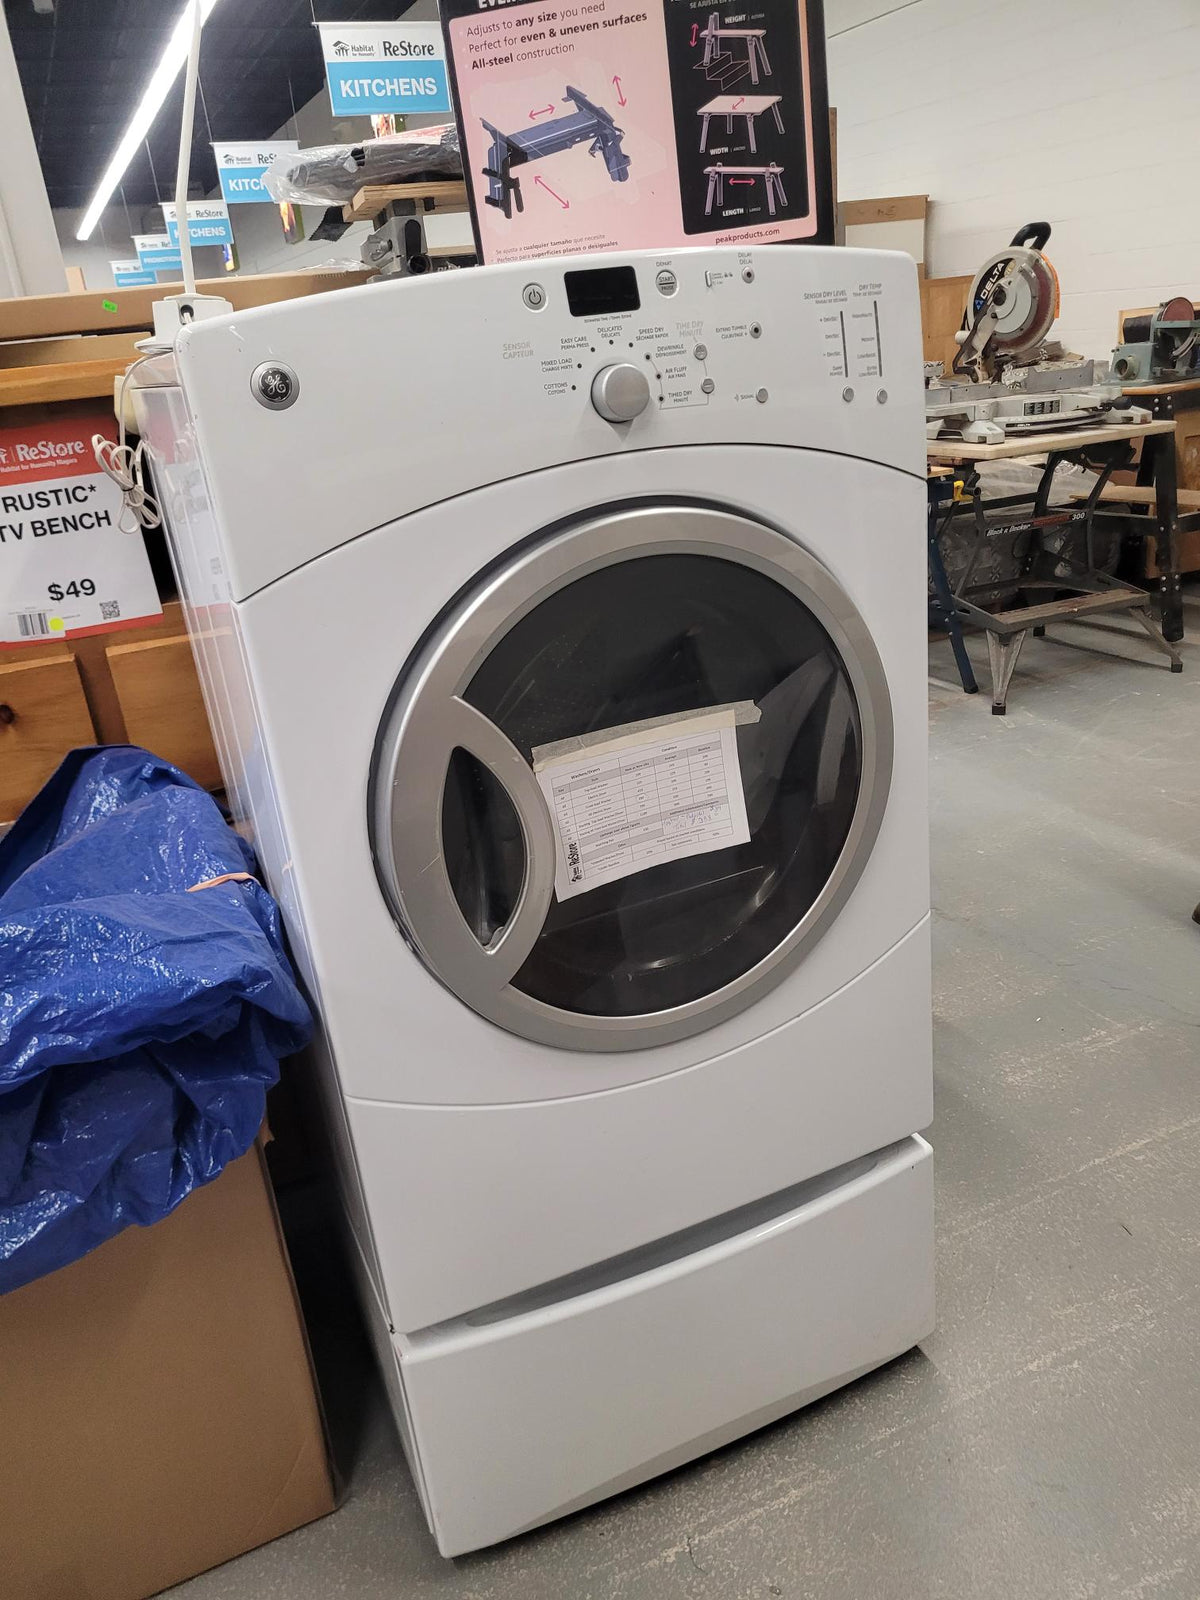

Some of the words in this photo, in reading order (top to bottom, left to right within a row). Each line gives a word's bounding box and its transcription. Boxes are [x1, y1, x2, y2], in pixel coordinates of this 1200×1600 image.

[466, 22, 500, 38] Adjusts
[502, 21, 512, 30] to
[516, 16, 534, 28] any
[538, 12, 558, 22] size
[560, 8, 578, 21] you
[581, 2, 606, 14] need
[724, 14, 746, 24] HEIGHT
[469, 39, 501, 53] Perfect
[504, 36, 518, 48] for
[520, 32, 546, 44] even
[549, 28, 556, 38] &
[560, 21, 600, 36] uneven
[602, 12, 648, 29] surfaces
[383, 40, 435, 56] ReStore
[472, 53, 514, 70] All-steel
[516, 42, 575, 62] construction
[340, 78, 438, 98] KITCHENS
[258, 153, 276, 164] ReS
[710, 146, 728, 156] WIDTH
[196, 210, 224, 218] ReStore
[722, 208, 744, 216] LENGTH
[716, 228, 780, 244] peakproducts.com
[524, 243, 548, 252] cualquier
[532, 249, 562, 258] superficies
[588, 241, 618, 250] desiguales
[980, 262, 1004, 300] DELTA
[503, 342, 531, 351] SENSOR
[502, 350, 534, 360] CAPTEUR
[544, 382, 568, 390] COTTONS
[16, 441, 82, 462] ReStore
[1072, 512, 1085, 520] 300
[0, 522, 22, 542] TV
[30, 510, 112, 537] BENCH
[48, 578, 96, 603] $49
